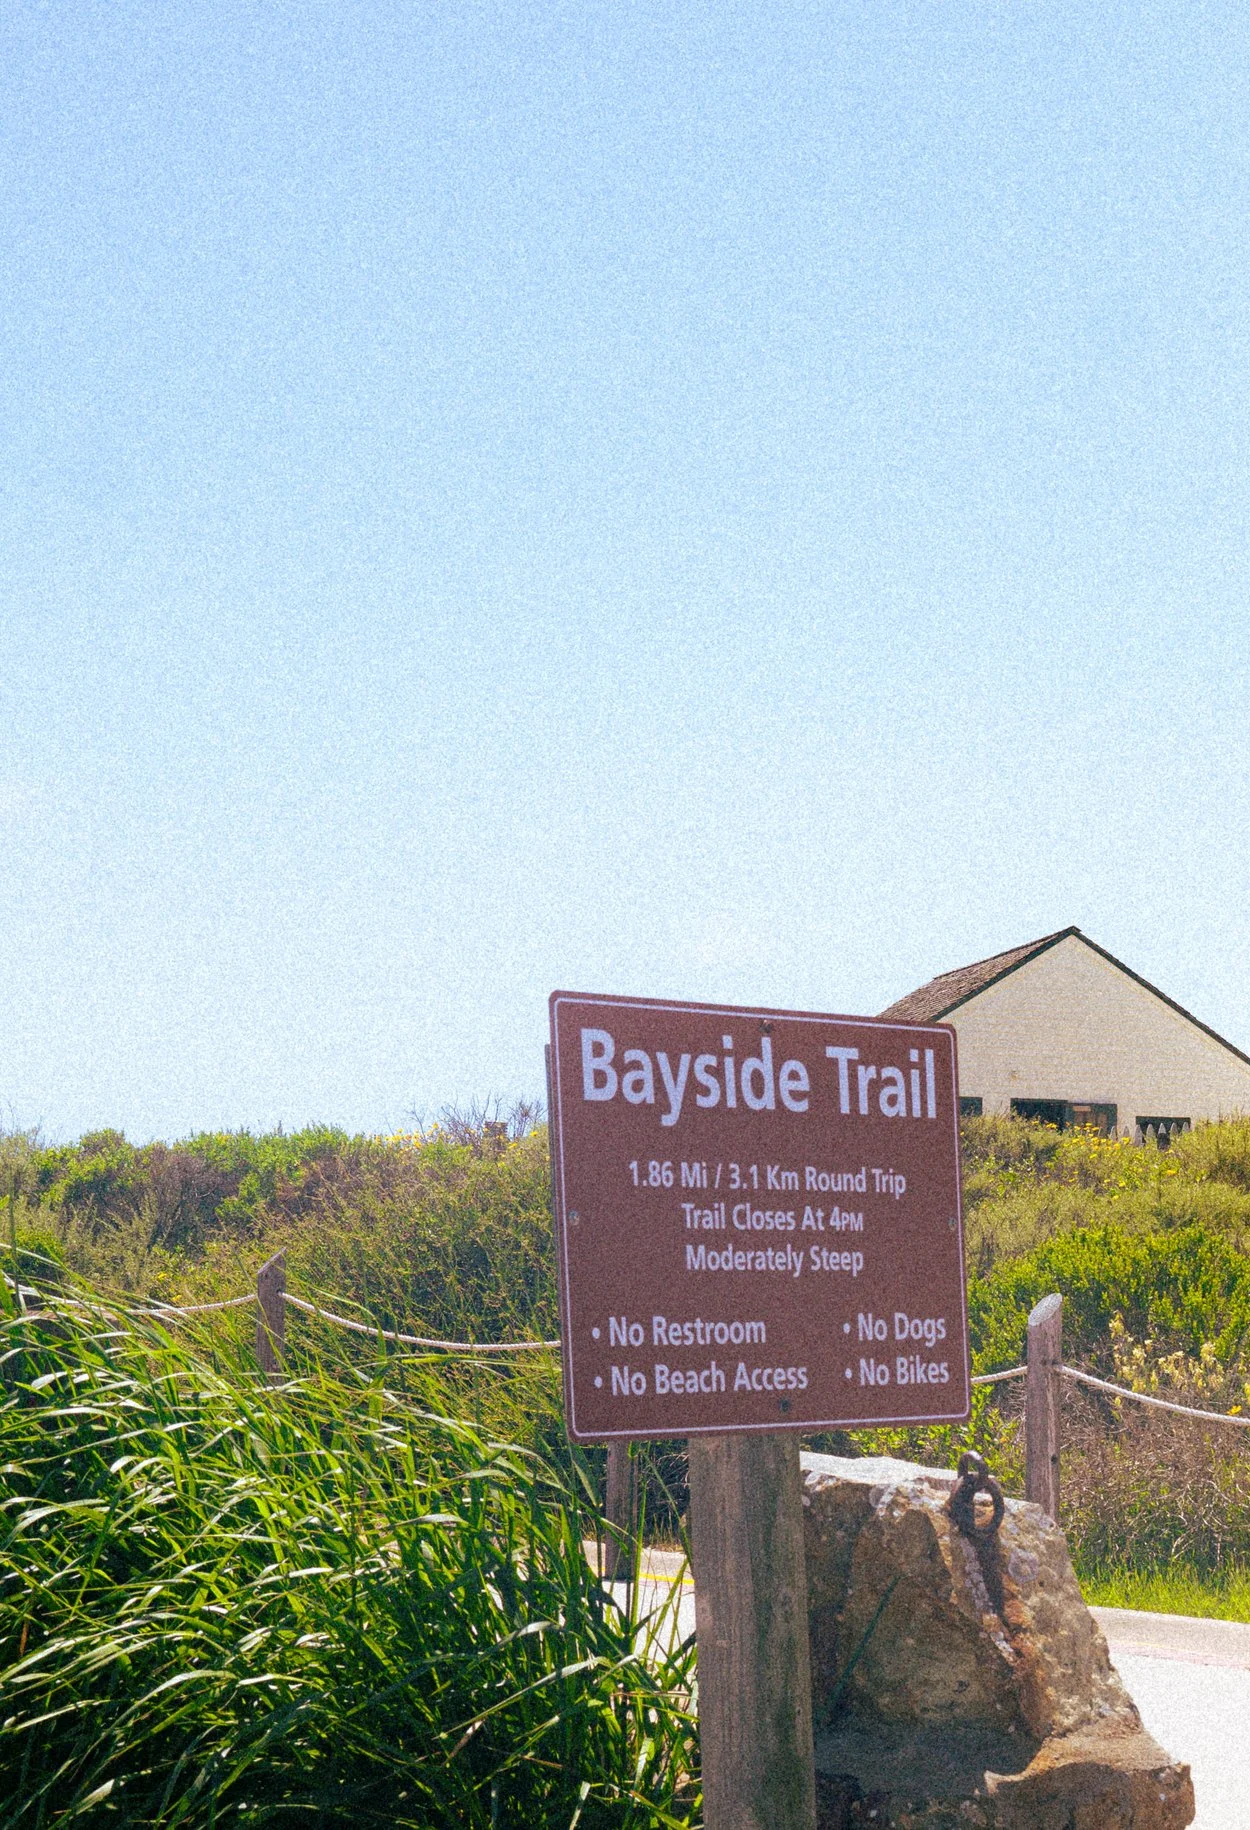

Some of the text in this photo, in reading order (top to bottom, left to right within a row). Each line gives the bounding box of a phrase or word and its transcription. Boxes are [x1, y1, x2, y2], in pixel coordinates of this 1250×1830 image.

[581, 1028, 937, 1126] Bayside Trail
[628, 1160, 674, 1189] 1.86
[680, 1161, 708, 1190] Mi
[729, 1165, 759, 1191] 3.1
[766, 1165, 800, 1192] Km
[805, 1166, 866, 1194] Round
[872, 1168, 906, 1200] Trip
[681, 1203, 864, 1233] Trail Closes At 4PM
[686, 1244, 864, 1277] Moderately Steep
[608, 1315, 767, 1347] No Restroom
[857, 1312, 946, 1349] No Dogs
[610, 1361, 808, 1396] No Beach Access
[859, 1355, 950, 1387] No Bikes
